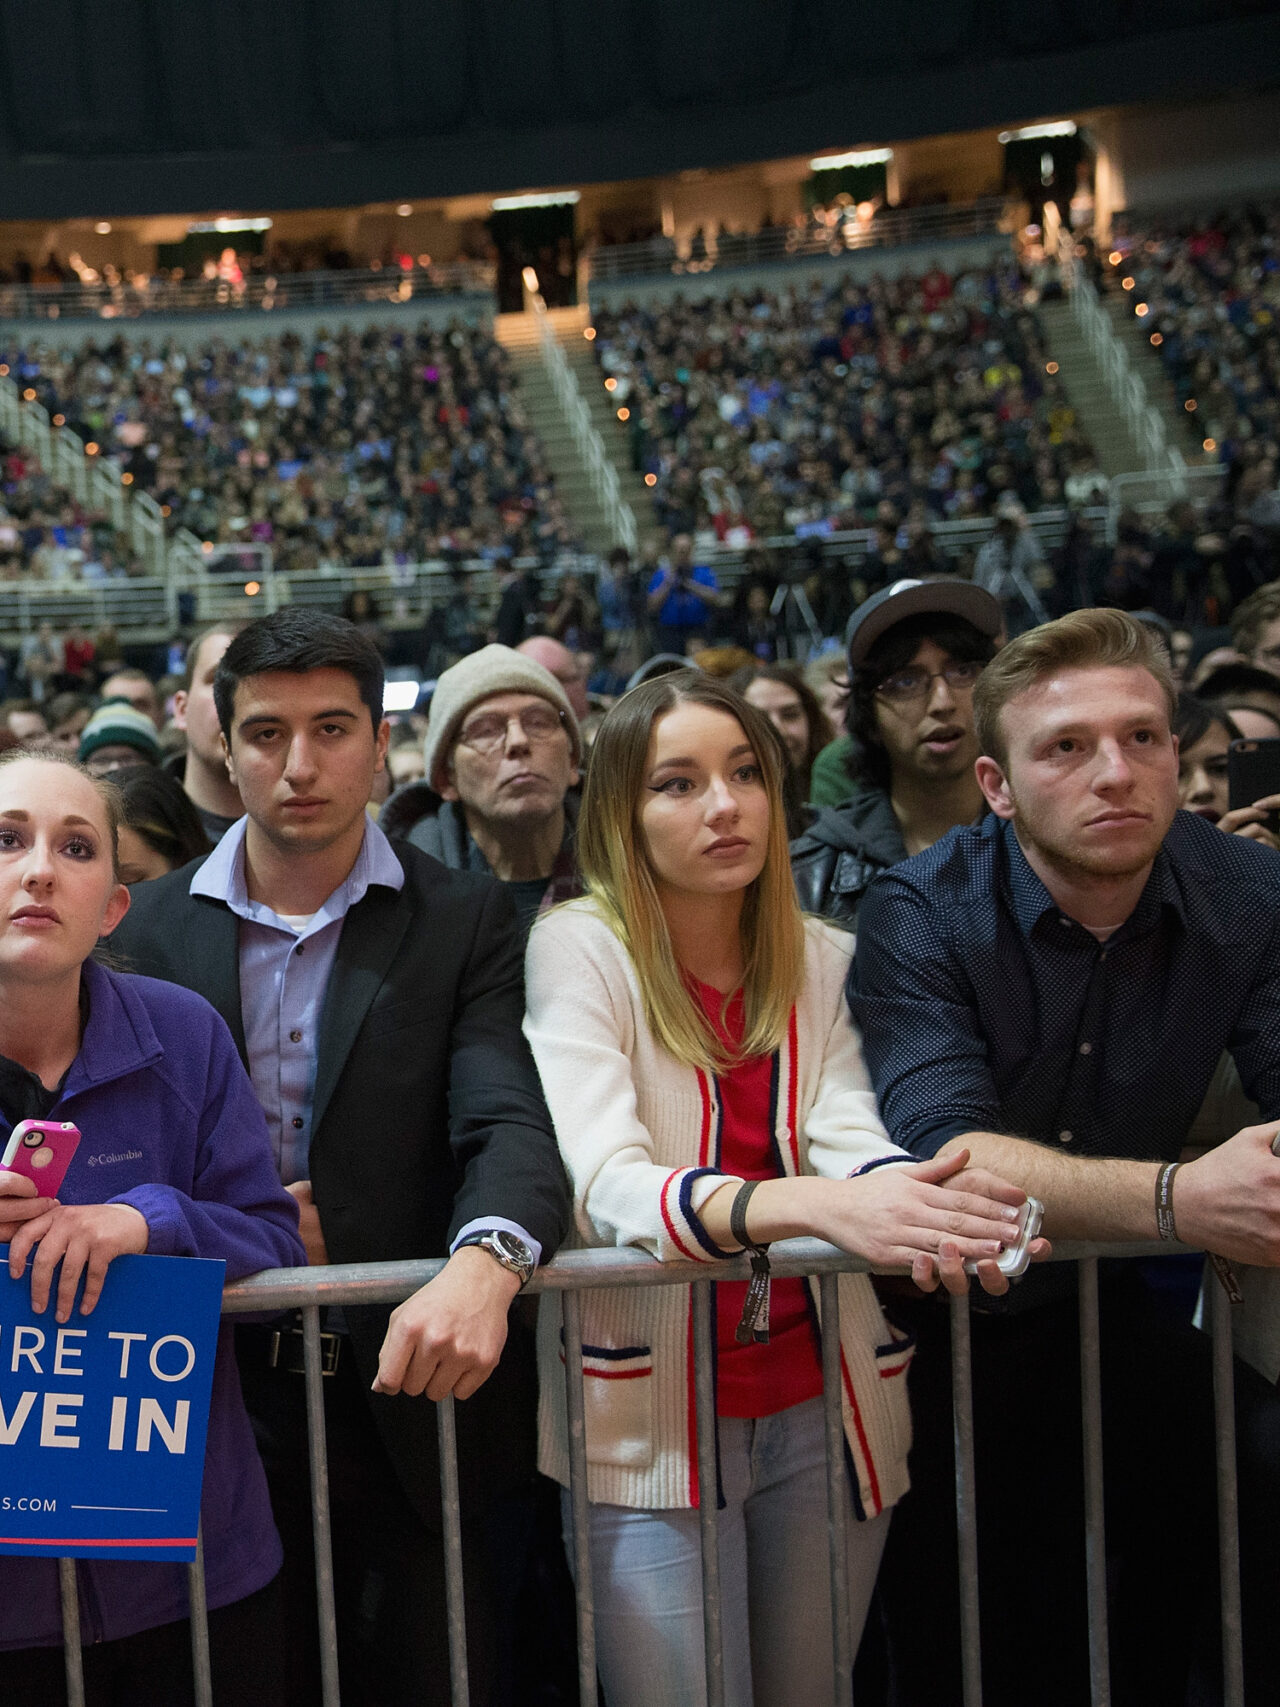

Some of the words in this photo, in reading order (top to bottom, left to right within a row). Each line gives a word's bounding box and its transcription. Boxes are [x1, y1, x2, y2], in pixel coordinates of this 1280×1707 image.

[98, 1149, 143, 1165] Columbia
[108, 1331, 196, 1382] TO
[108, 1396, 191, 1454] IN
